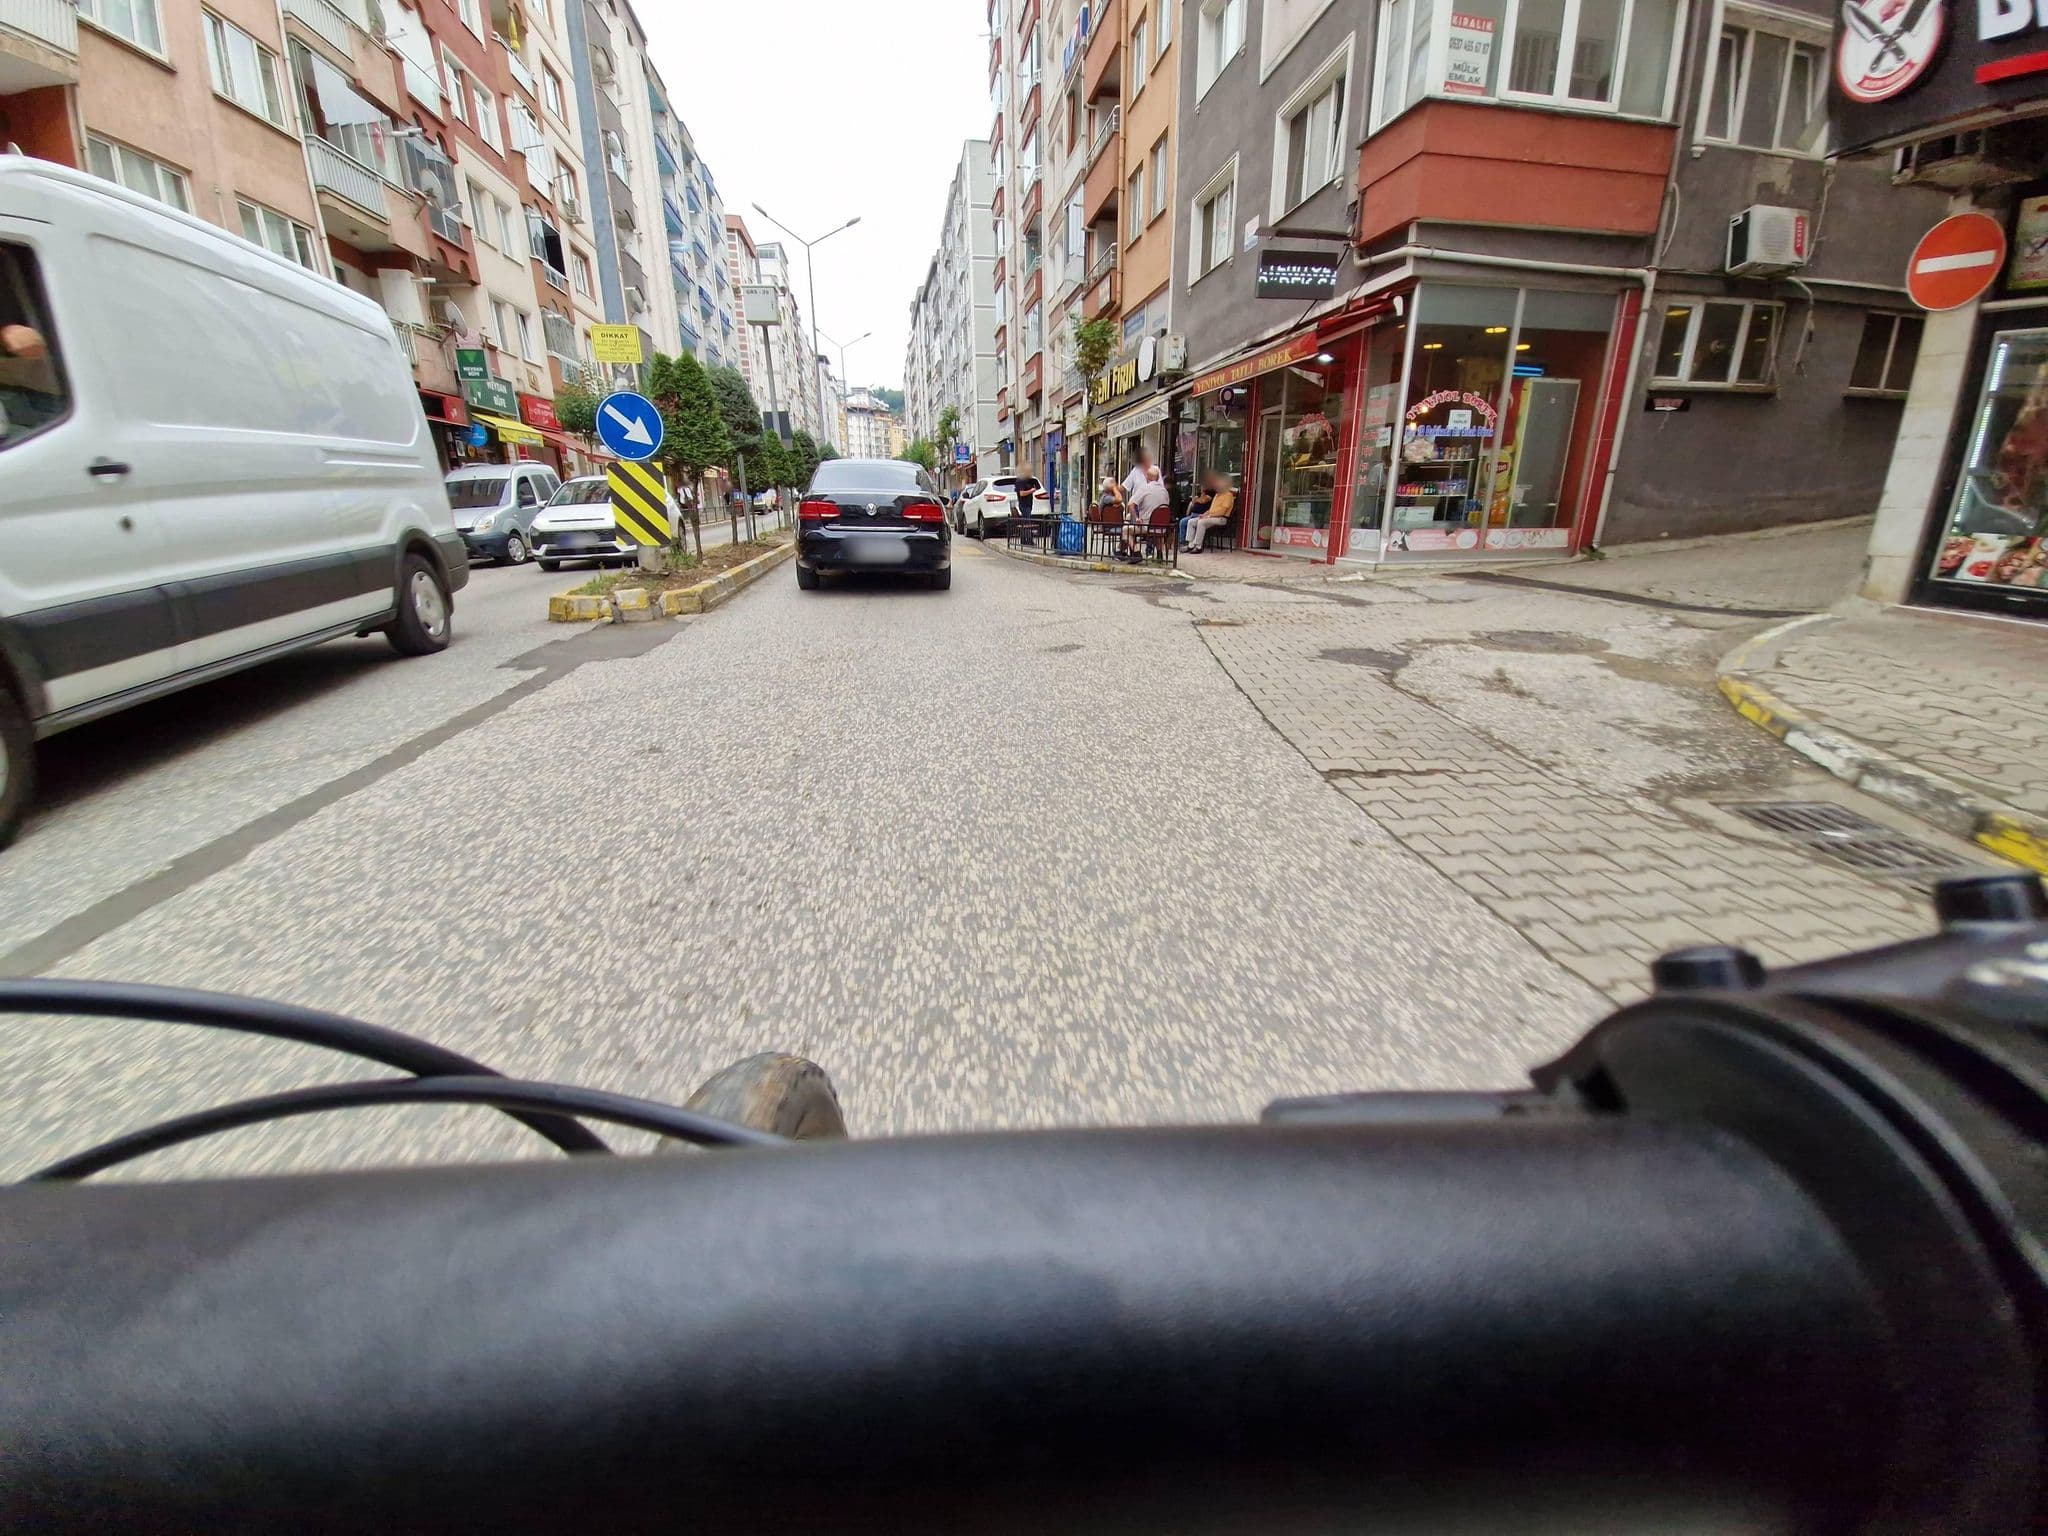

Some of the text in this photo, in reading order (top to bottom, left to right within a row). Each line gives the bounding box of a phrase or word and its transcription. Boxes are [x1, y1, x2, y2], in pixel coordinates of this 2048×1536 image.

[1452, 15, 1493, 31] KIRALIK
[1453, 62, 1480, 74] MÜLK
[1448, 72, 1480, 84] EMLAK
[1258, 348, 1294, 370] BÖREK
